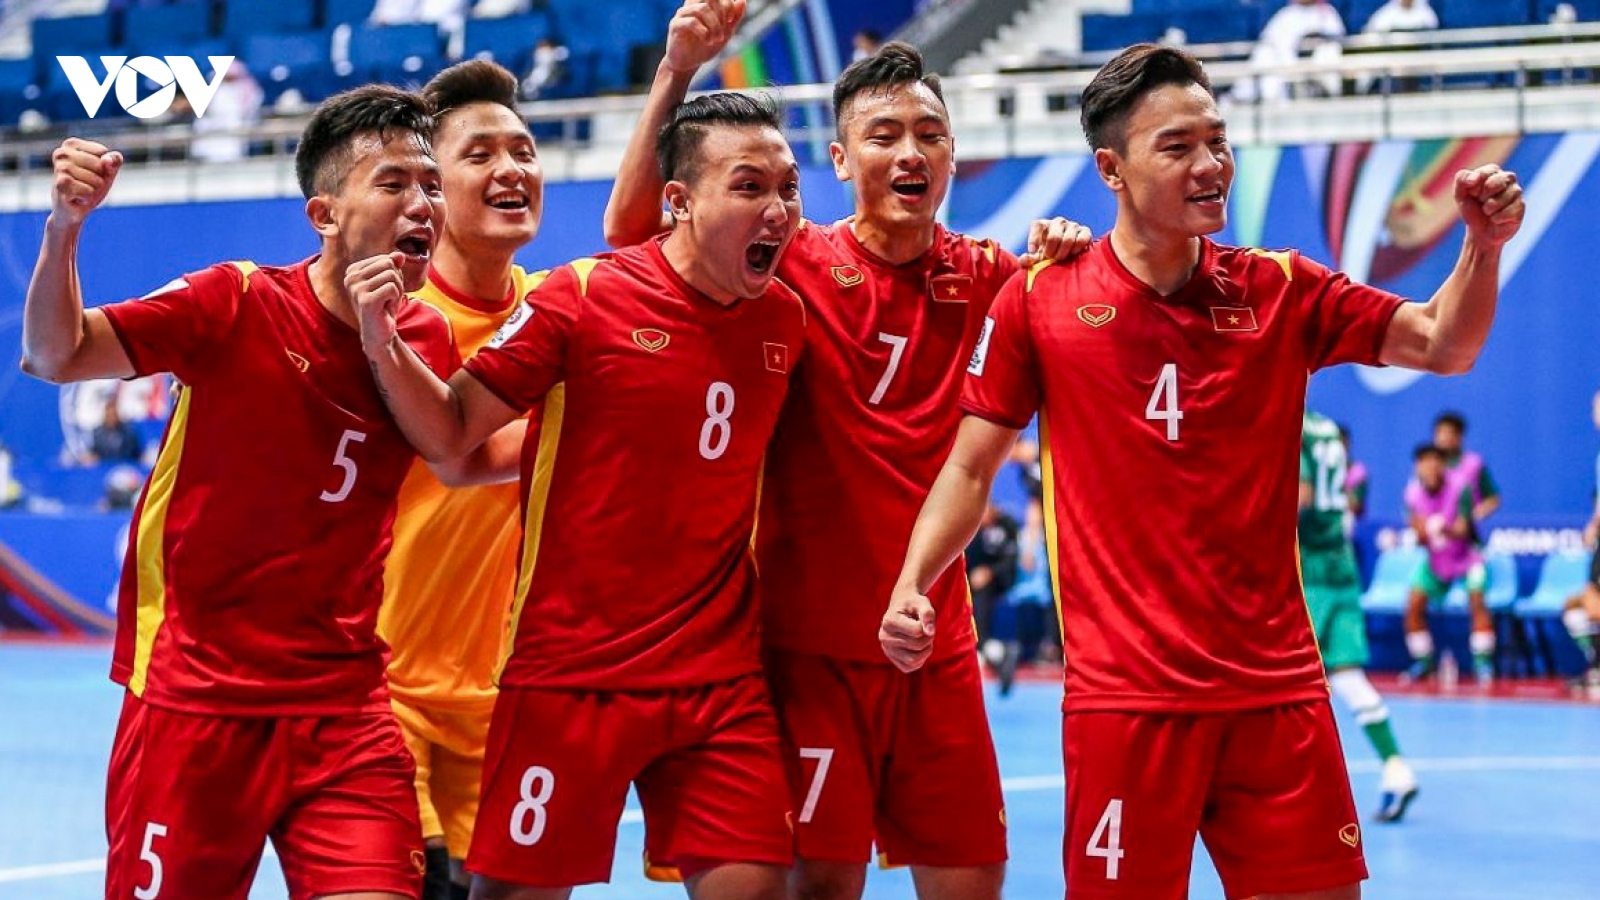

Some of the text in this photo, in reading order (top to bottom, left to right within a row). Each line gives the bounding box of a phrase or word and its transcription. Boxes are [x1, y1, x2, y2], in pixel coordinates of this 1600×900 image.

[868, 331, 907, 406] 7
[1145, 363, 1184, 442] 4
[698, 381, 735, 461] 8
[318, 428, 367, 503] 5
[1312, 439, 1347, 511] 12
[509, 765, 555, 847] 8
[798, 747, 833, 823] 7
[133, 821, 168, 900] 5
[1085, 798, 1124, 881] 4
